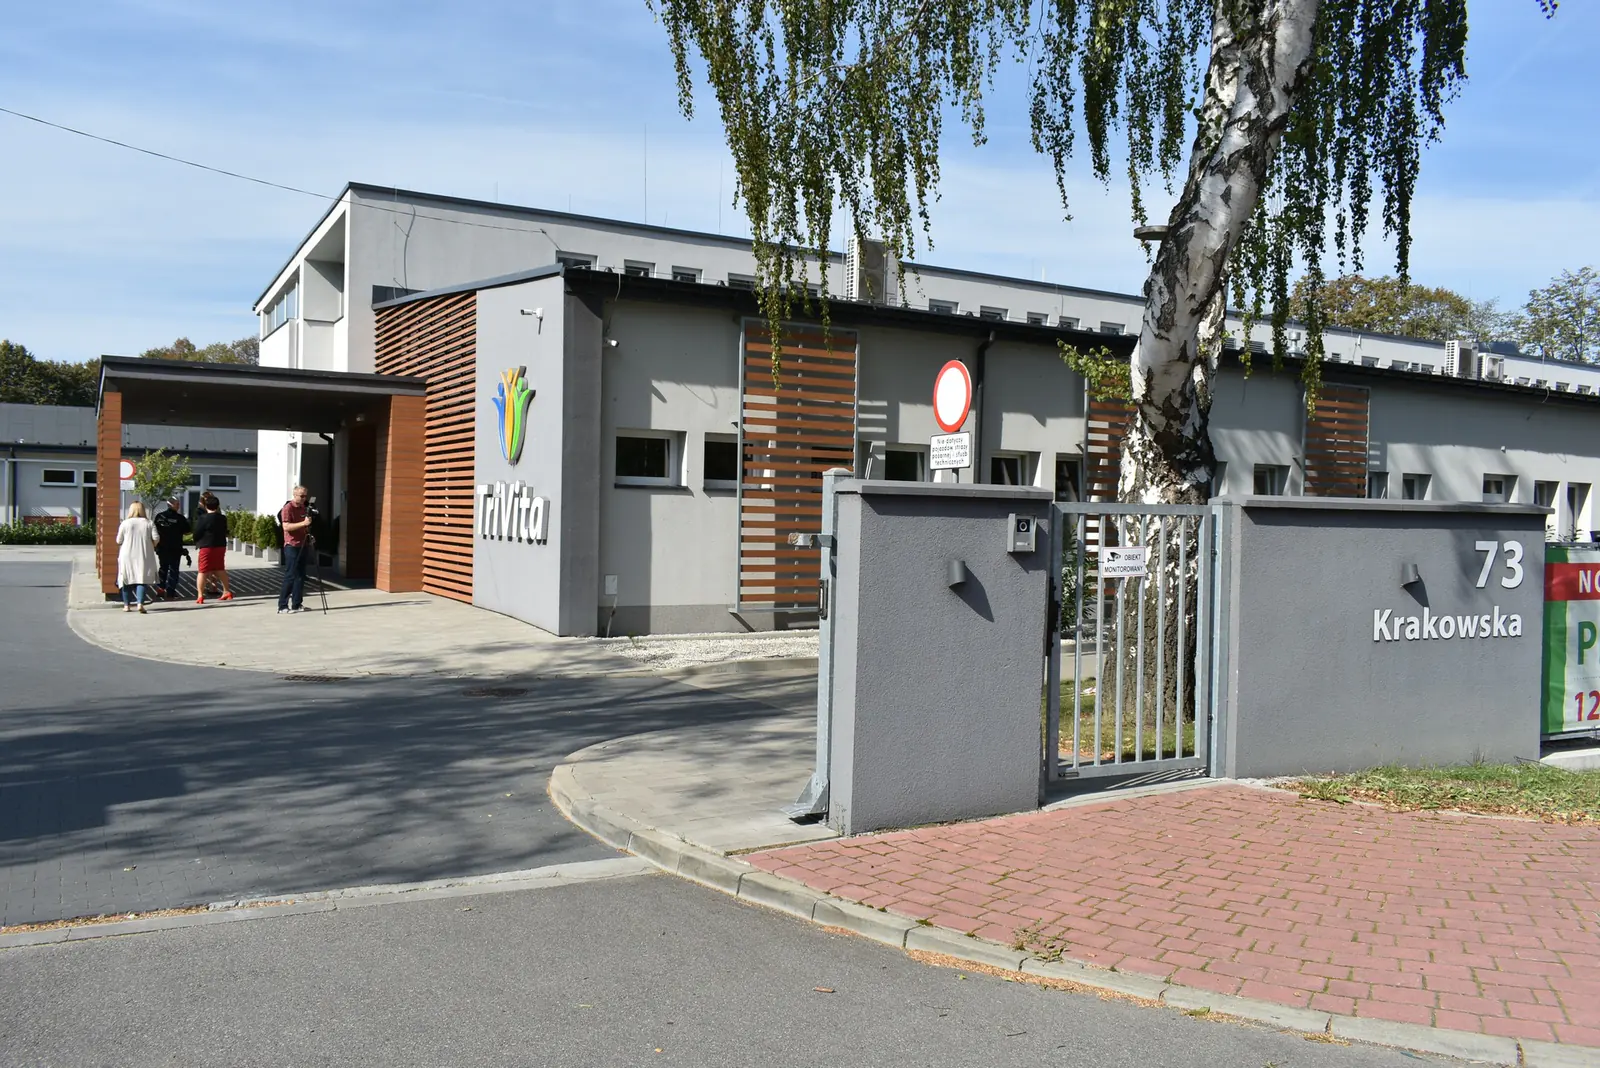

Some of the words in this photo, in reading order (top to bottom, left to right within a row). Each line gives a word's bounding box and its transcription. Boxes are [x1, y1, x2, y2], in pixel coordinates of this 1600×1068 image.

[477, 480, 547, 541] TriVita
[1104, 565, 1143, 573] MONITOROWANY
[1475, 540, 1524, 589] 73
[1373, 605, 1522, 641] Krakowska
